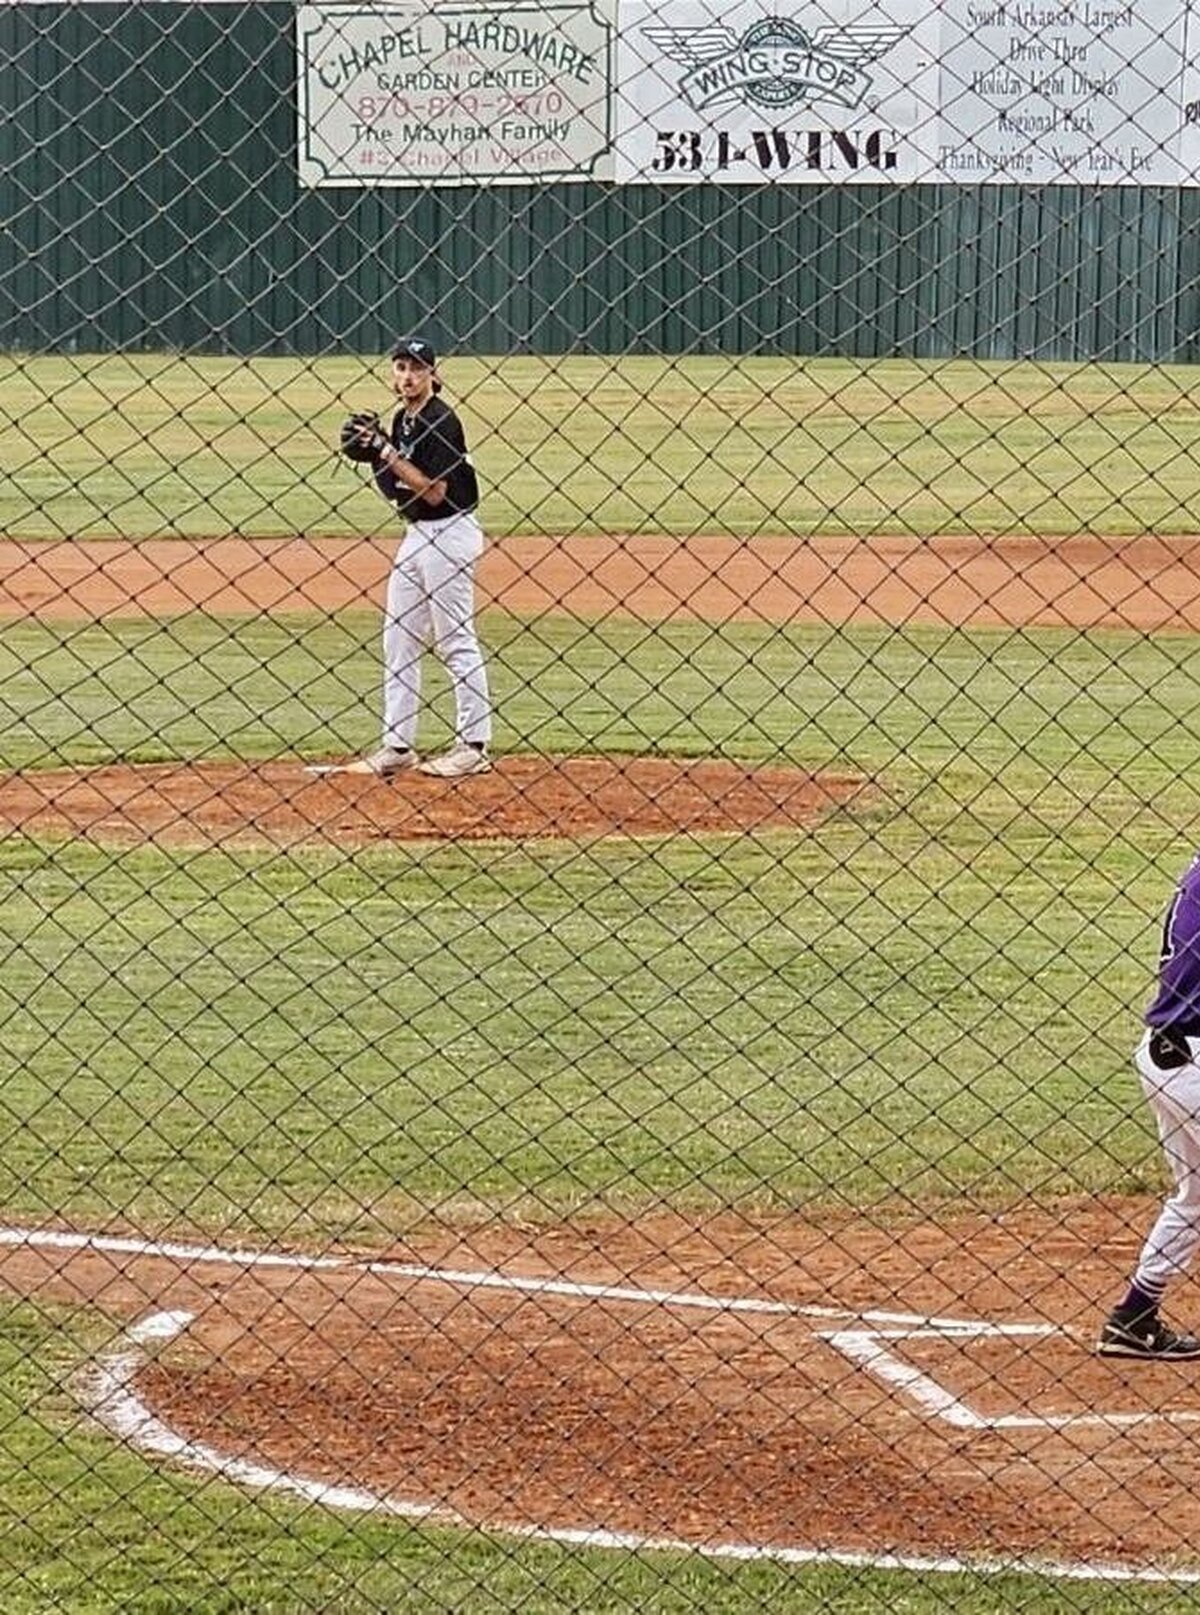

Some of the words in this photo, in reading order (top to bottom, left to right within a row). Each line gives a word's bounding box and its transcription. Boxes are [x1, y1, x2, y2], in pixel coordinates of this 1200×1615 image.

[966, 3, 1006, 28] South
[1085, 2, 1132, 33] Largest
[317, 27, 432, 89] CHAPEL
[445, 21, 596, 85] HARDWARE
[1009, 37, 1045, 61] Drive
[377, 72, 459, 91] GARDEN
[468, 70, 545, 89] CENTER
[972, 71, 1022, 97] Holiday
[350, 123, 393, 142] The
[501, 119, 571, 142] Family
